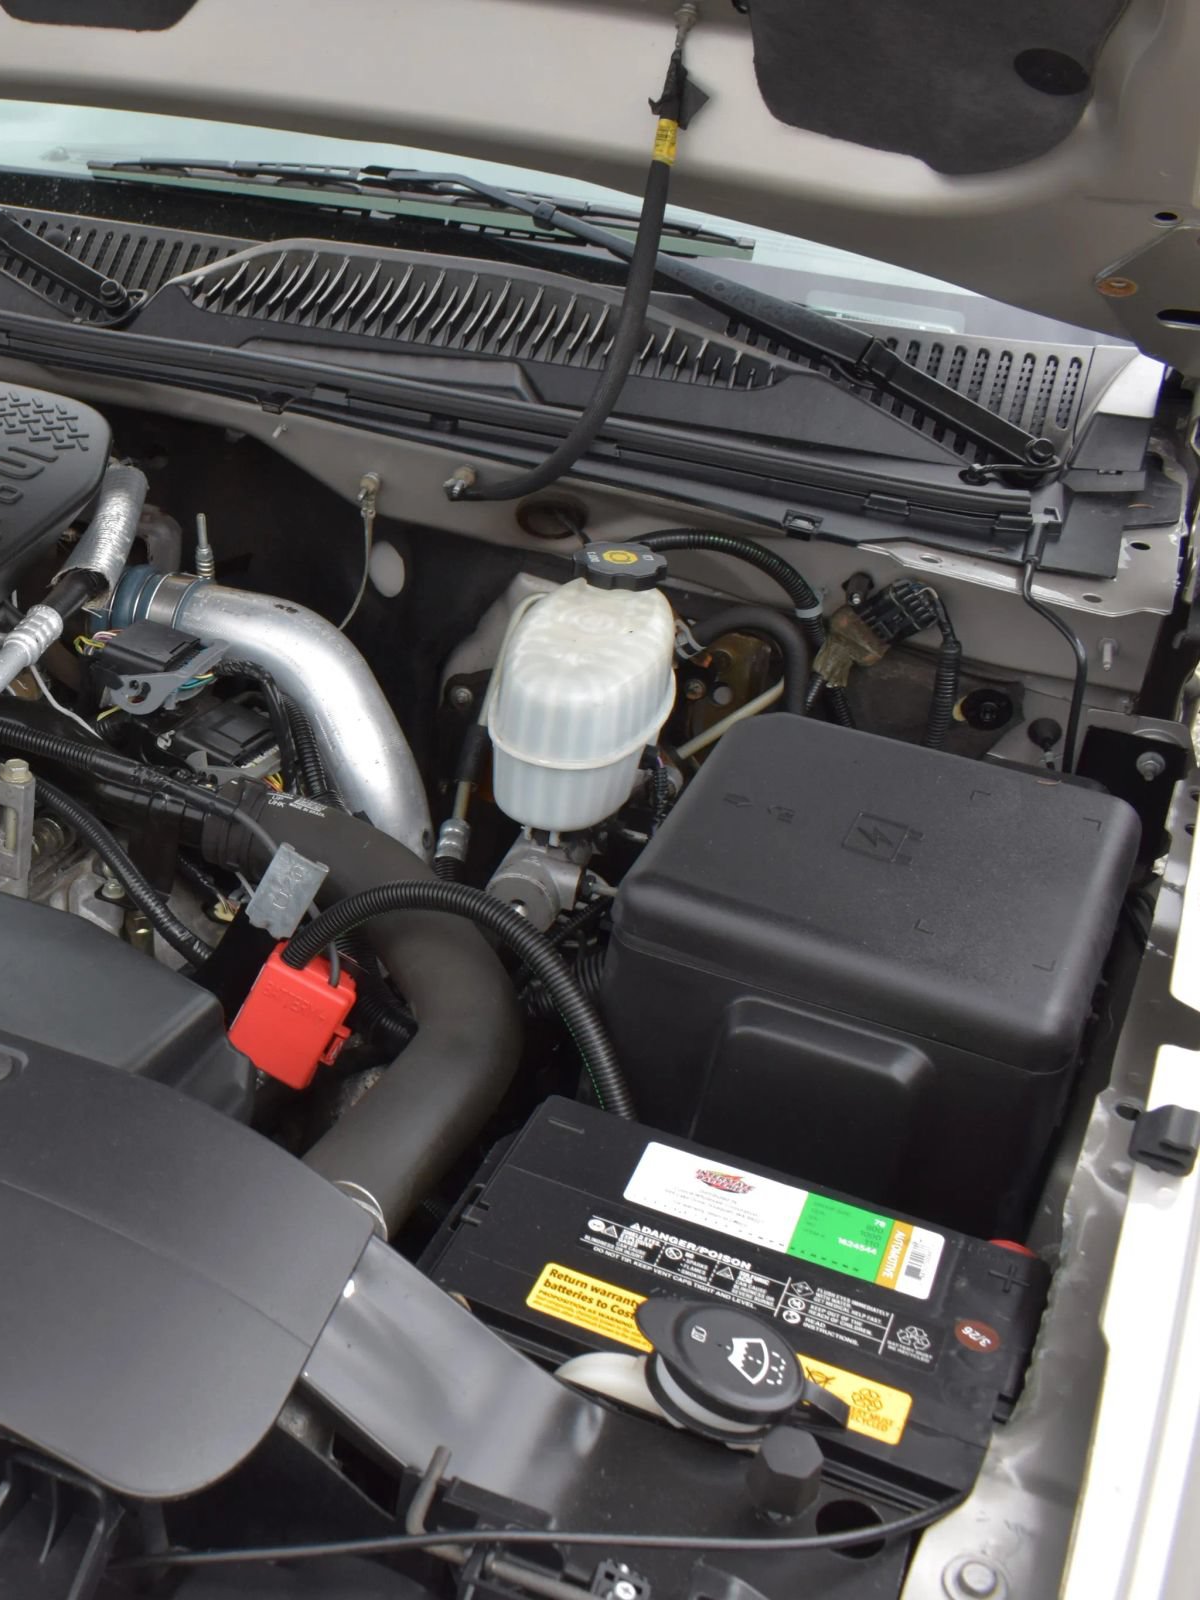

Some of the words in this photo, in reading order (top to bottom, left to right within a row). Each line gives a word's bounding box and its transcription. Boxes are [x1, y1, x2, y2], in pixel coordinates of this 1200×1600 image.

[695, 1169, 755, 1191] INTERSTATE
[695, 1175, 747, 1193] BATTERIES
[641, 1225, 752, 1270] DANGER/POISON
[882, 1230, 906, 1279] AUTOMOTIVE
[549, 1268, 588, 1289] Return
[605, 1250, 619, 1258] NOT
[633, 1259, 652, 1270] KEEP
[654, 1267, 673, 1279] VENT
[673, 1275, 693, 1287] CAPS
[693, 1282, 714, 1293] TIGHT
[715, 1289, 731, 1300] AND
[544, 1279, 593, 1304] batteries
[596, 1299, 608, 1310] to
[807, 1309, 830, 1320] REACH
[824, 1300, 851, 1313] MEDICAL
[850, 1300, 890, 1317] IMMEDIATELY
[961, 1326, 992, 1348] 3/26
